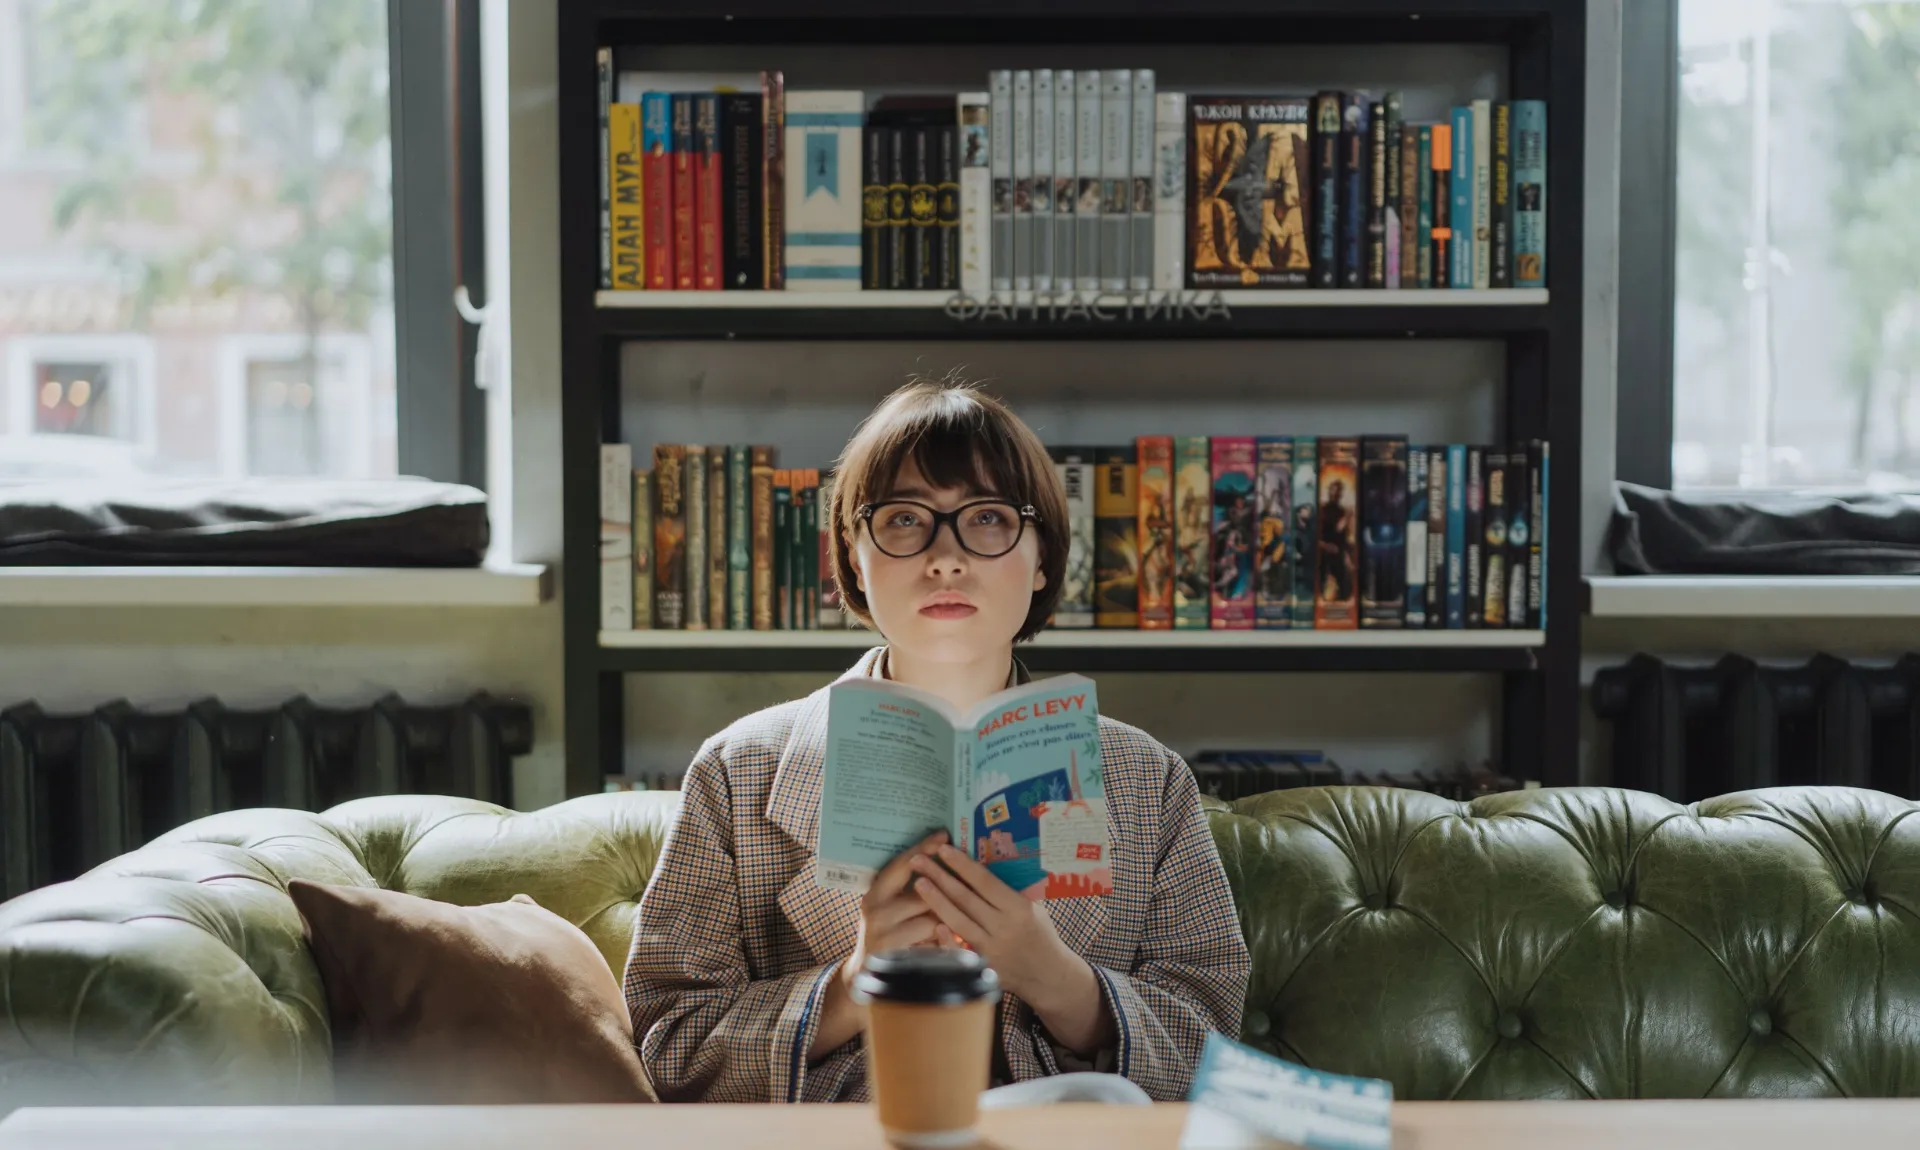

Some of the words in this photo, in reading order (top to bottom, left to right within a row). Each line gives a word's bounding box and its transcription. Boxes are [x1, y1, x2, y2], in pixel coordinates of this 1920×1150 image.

[1193, 104, 1242, 121] ДЖОН
[1248, 104, 1308, 121] КРАУЛИ
[616, 151, 640, 205] МУР
[616, 214, 640, 286] АЛАН
[945, 290, 1231, 321] ФАНТАСТИКА
[978, 706, 1029, 741] MARC
[1033, 693, 1086, 718] LEVY
[1019, 728, 1037, 738] ces
[1039, 721, 1077, 733] choses
[1043, 737, 1062, 748] pas
[1065, 731, 1093, 741] dites
